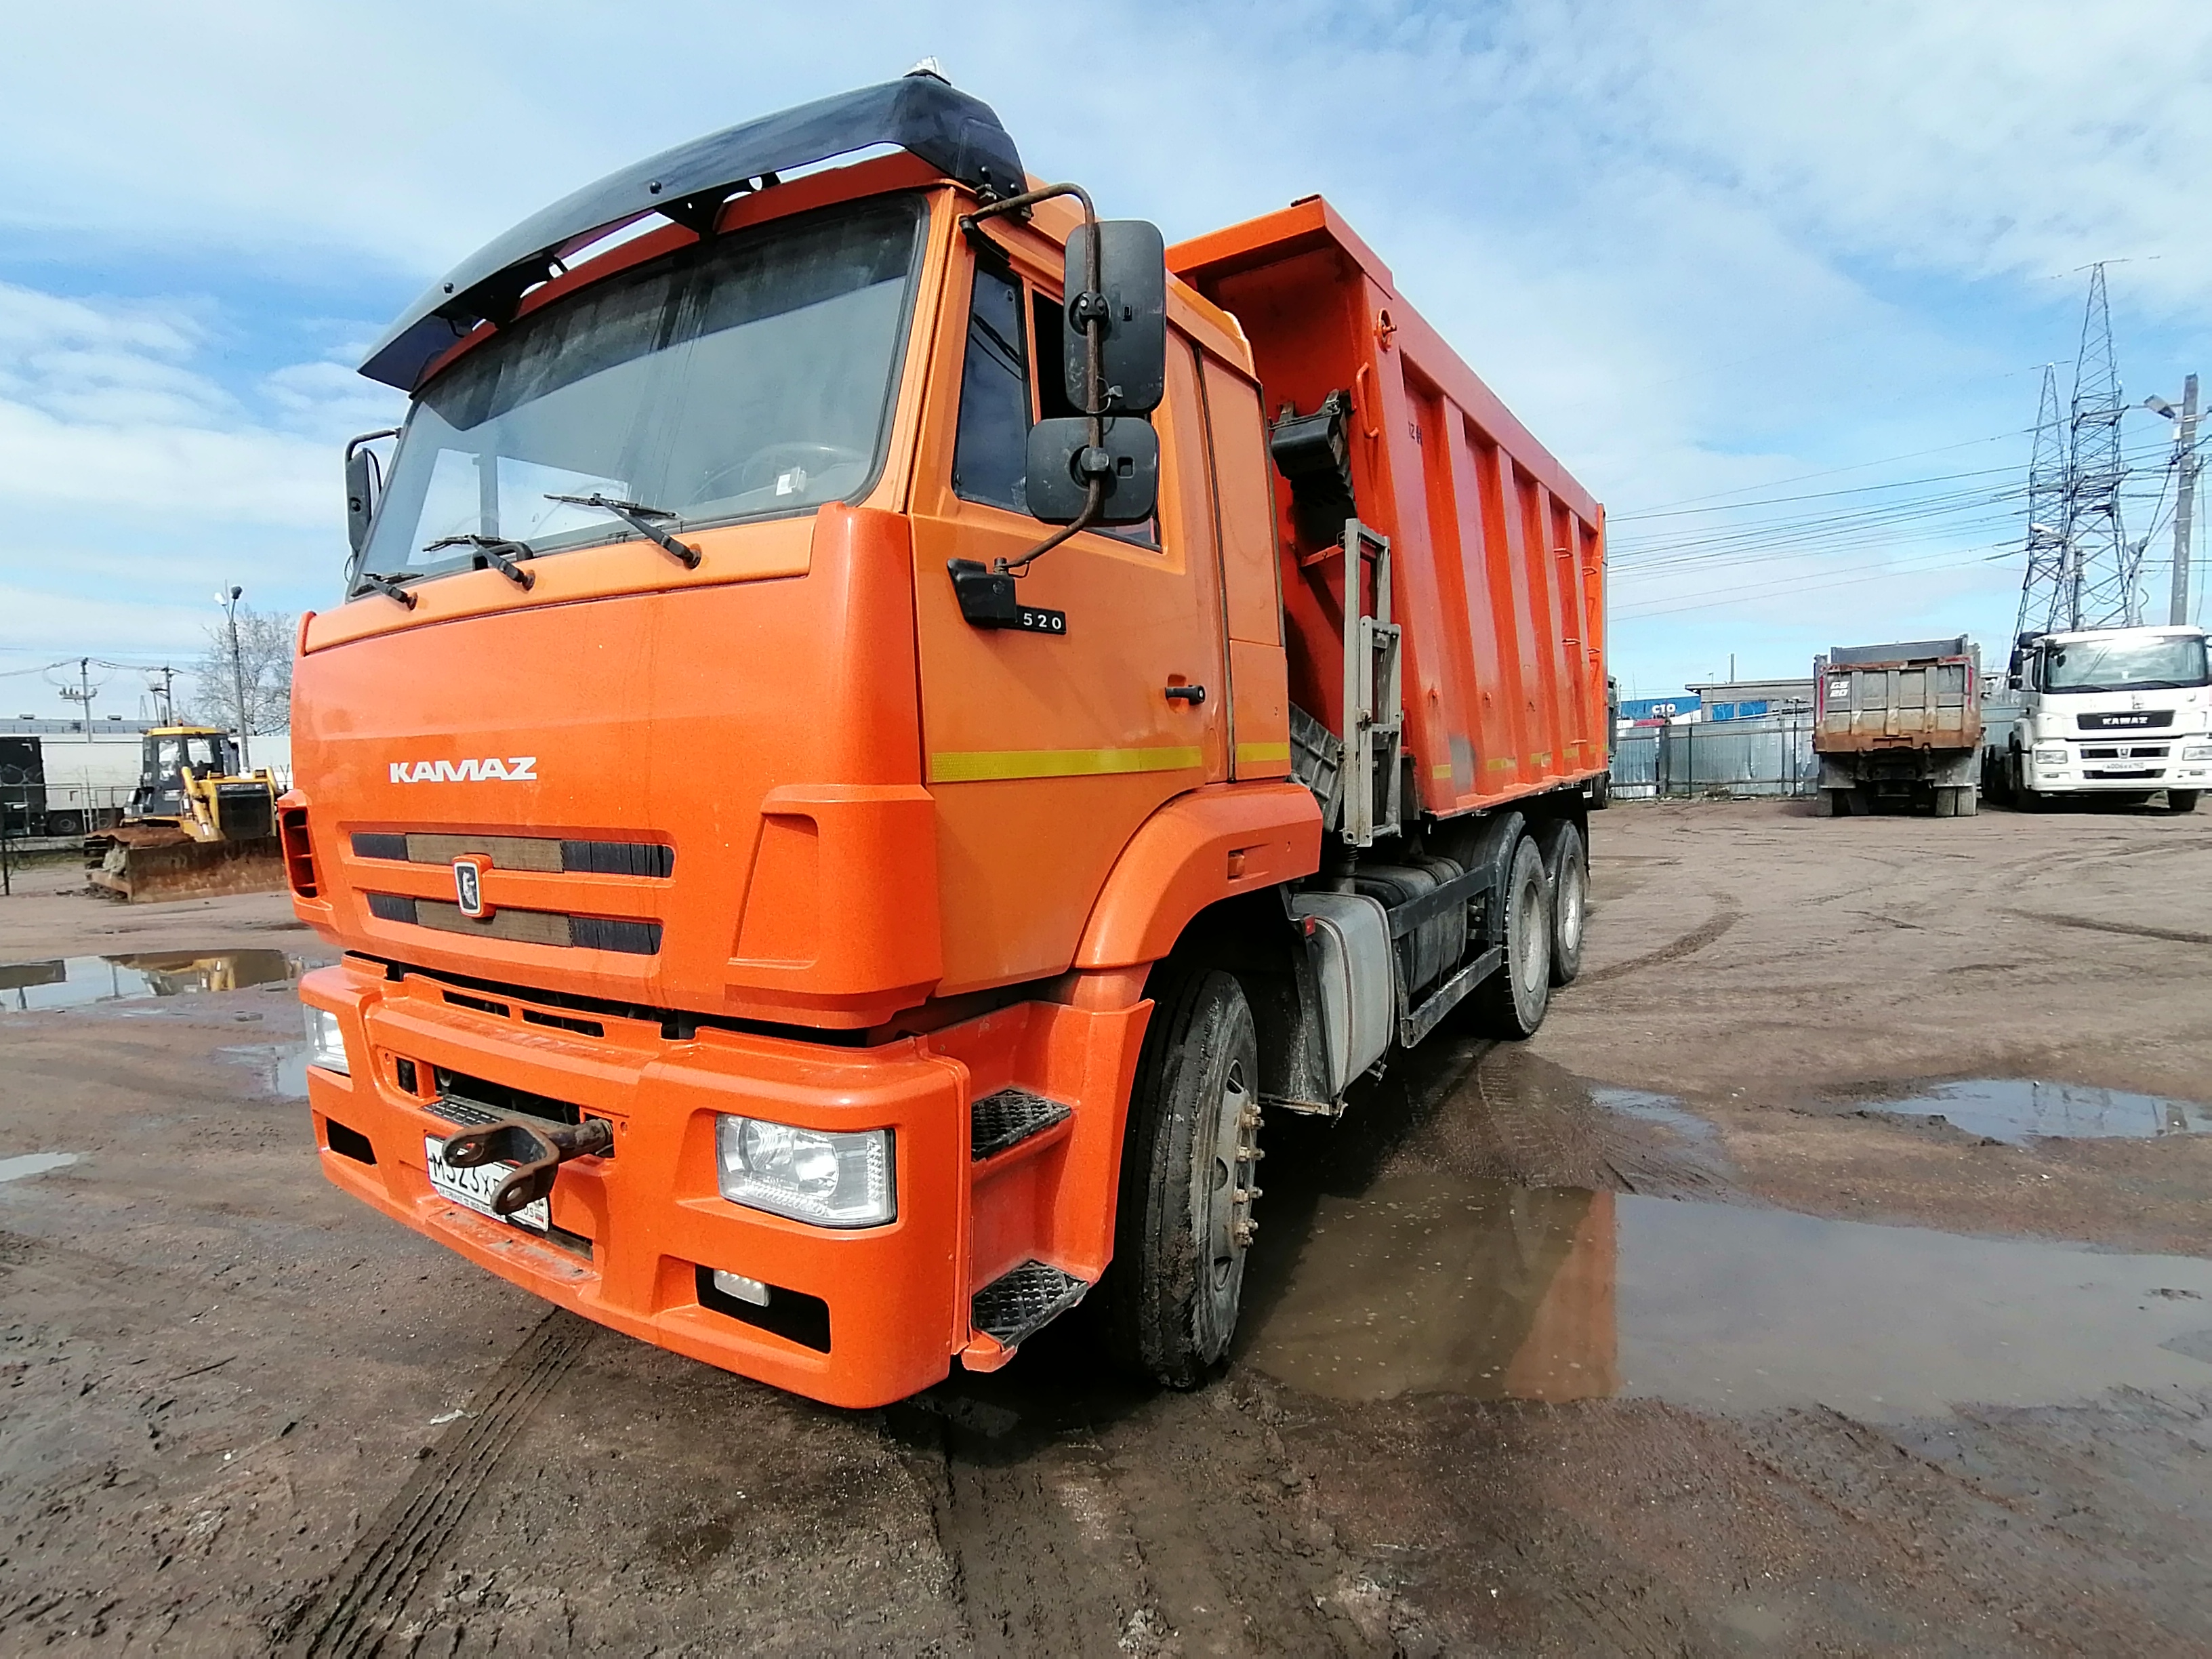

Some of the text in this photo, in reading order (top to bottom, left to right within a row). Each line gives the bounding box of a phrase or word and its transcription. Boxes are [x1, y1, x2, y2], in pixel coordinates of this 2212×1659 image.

[1023, 613, 1062, 630] 520
[1830, 689, 1848, 697] 20
[2102, 716, 2148, 725] KAMAZ
[390, 757, 537, 783] KAMAZ
